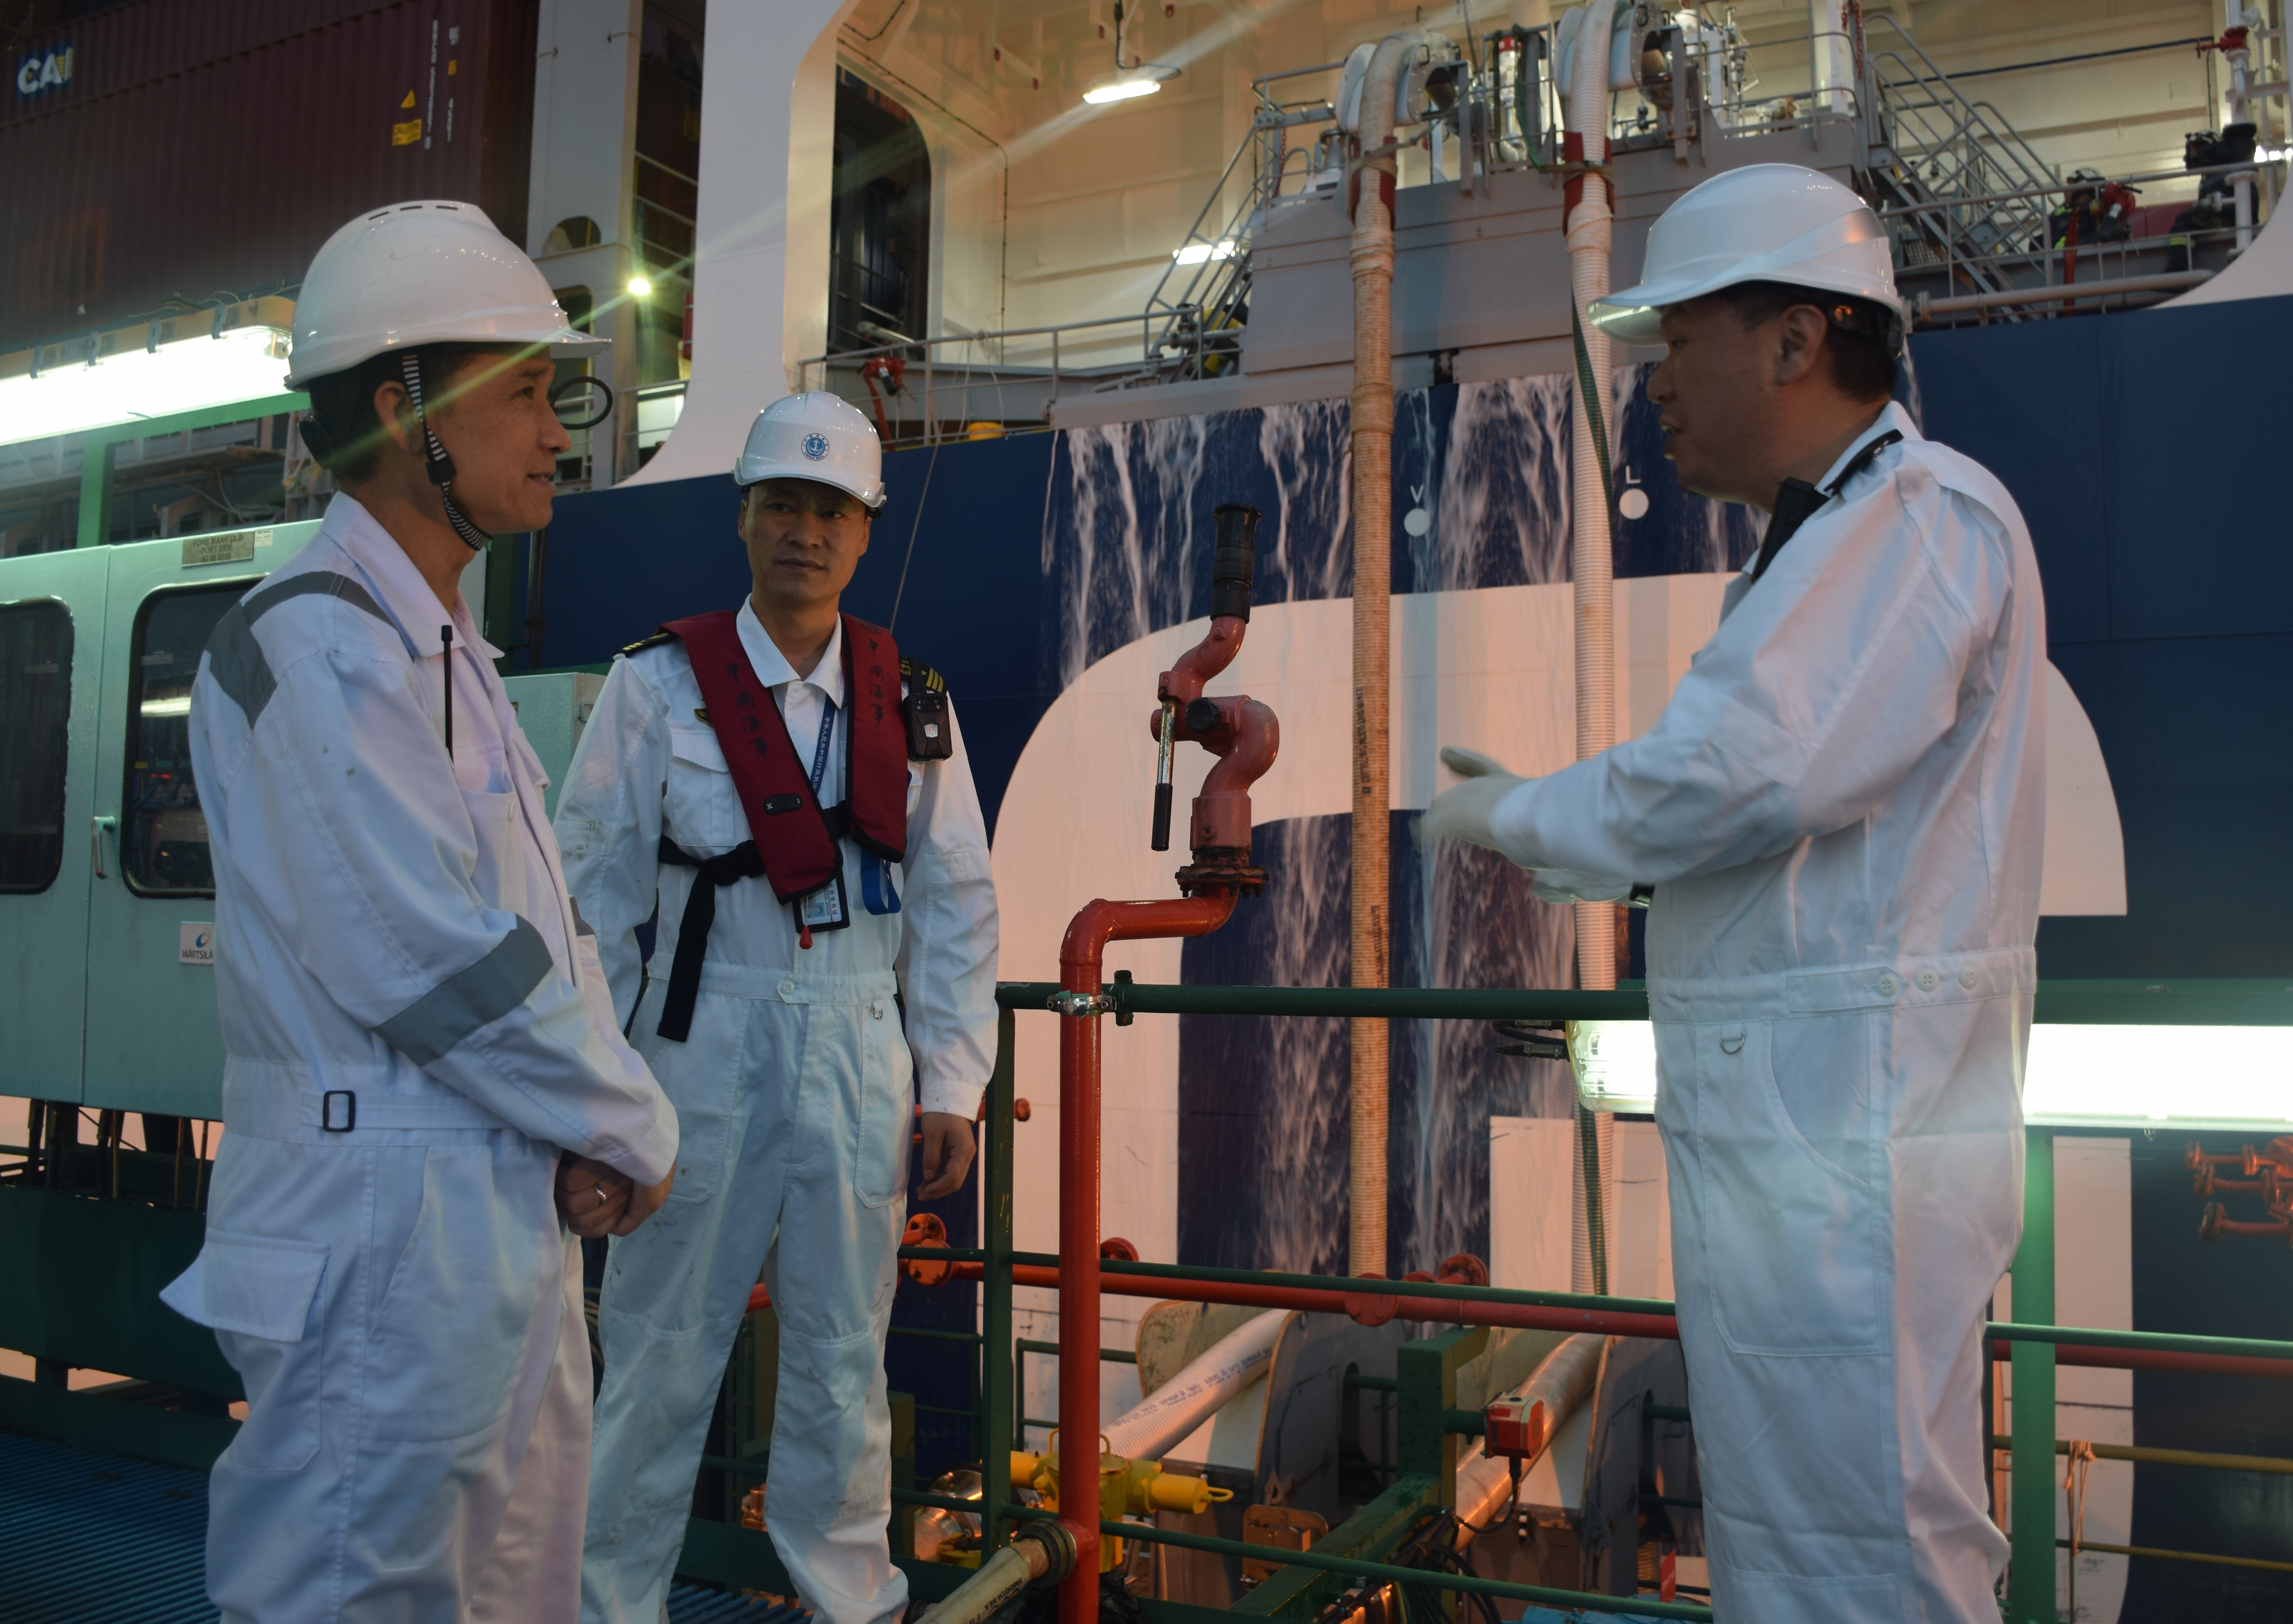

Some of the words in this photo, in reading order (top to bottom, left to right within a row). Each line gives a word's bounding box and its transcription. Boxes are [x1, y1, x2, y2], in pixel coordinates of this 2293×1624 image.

[17, 47, 72, 94] CAI
[1626, 465, 1642, 484] L
[193, 538, 209, 547] FORE
[210, 534, 243, 545] MANIFOLD
[997, 1577, 1023, 1599] SMOOTH
[984, 1599, 997, 1610] SEA
